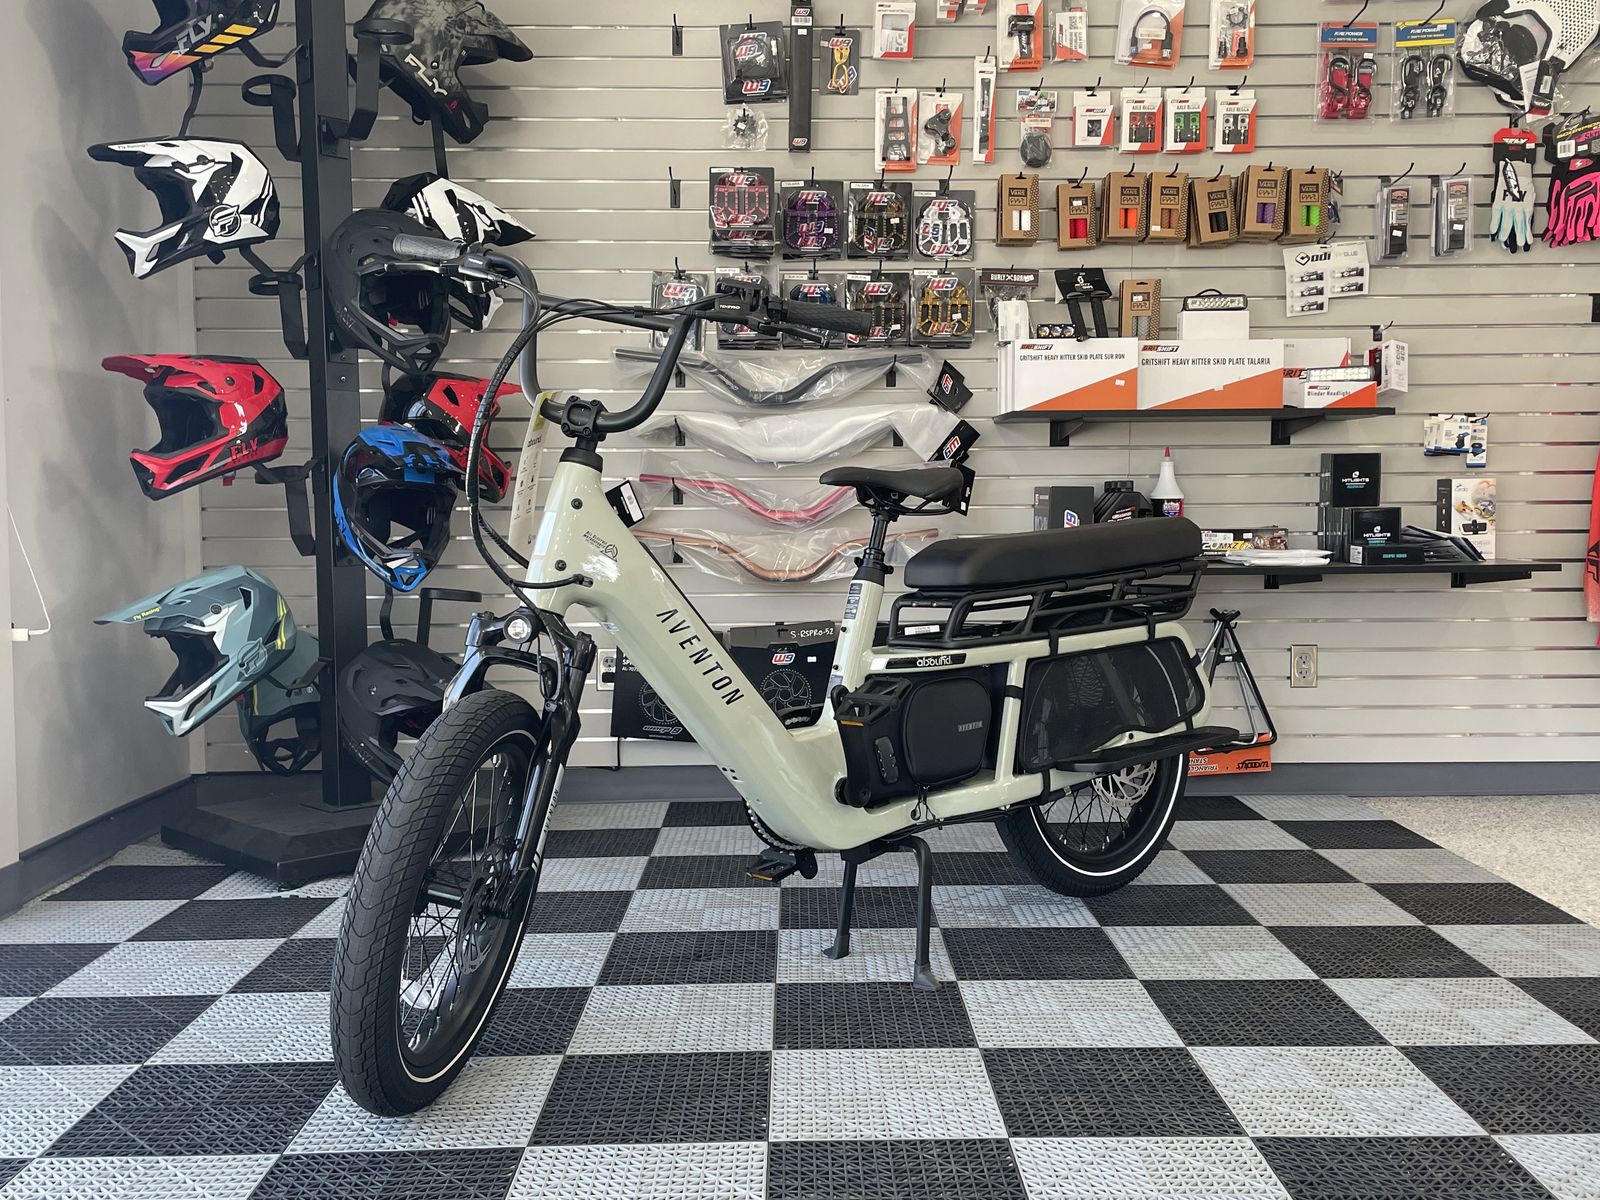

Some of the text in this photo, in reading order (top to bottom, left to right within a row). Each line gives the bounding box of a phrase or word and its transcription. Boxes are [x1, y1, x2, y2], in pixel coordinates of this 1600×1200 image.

[175, 13, 213, 52] FLY
[404, 53, 448, 96] FLY
[743, 79, 770, 93] W9
[990, 273, 1006, 281] BURLY
[864, 283, 892, 294] W9
[929, 278, 958, 290] W9
[1141, 358, 1170, 366] GRITSHIFT
[1172, 358, 1190, 366] HEAVY
[1228, 357, 1245, 365] PLATE
[1247, 357, 1271, 365] TALARIA
[230, 437, 258, 460] FLY
[141, 606, 161, 618] Racing
[655, 608, 745, 706] AVENTON
[773, 653, 795, 664] W9
[916, 655, 951, 667] abound
